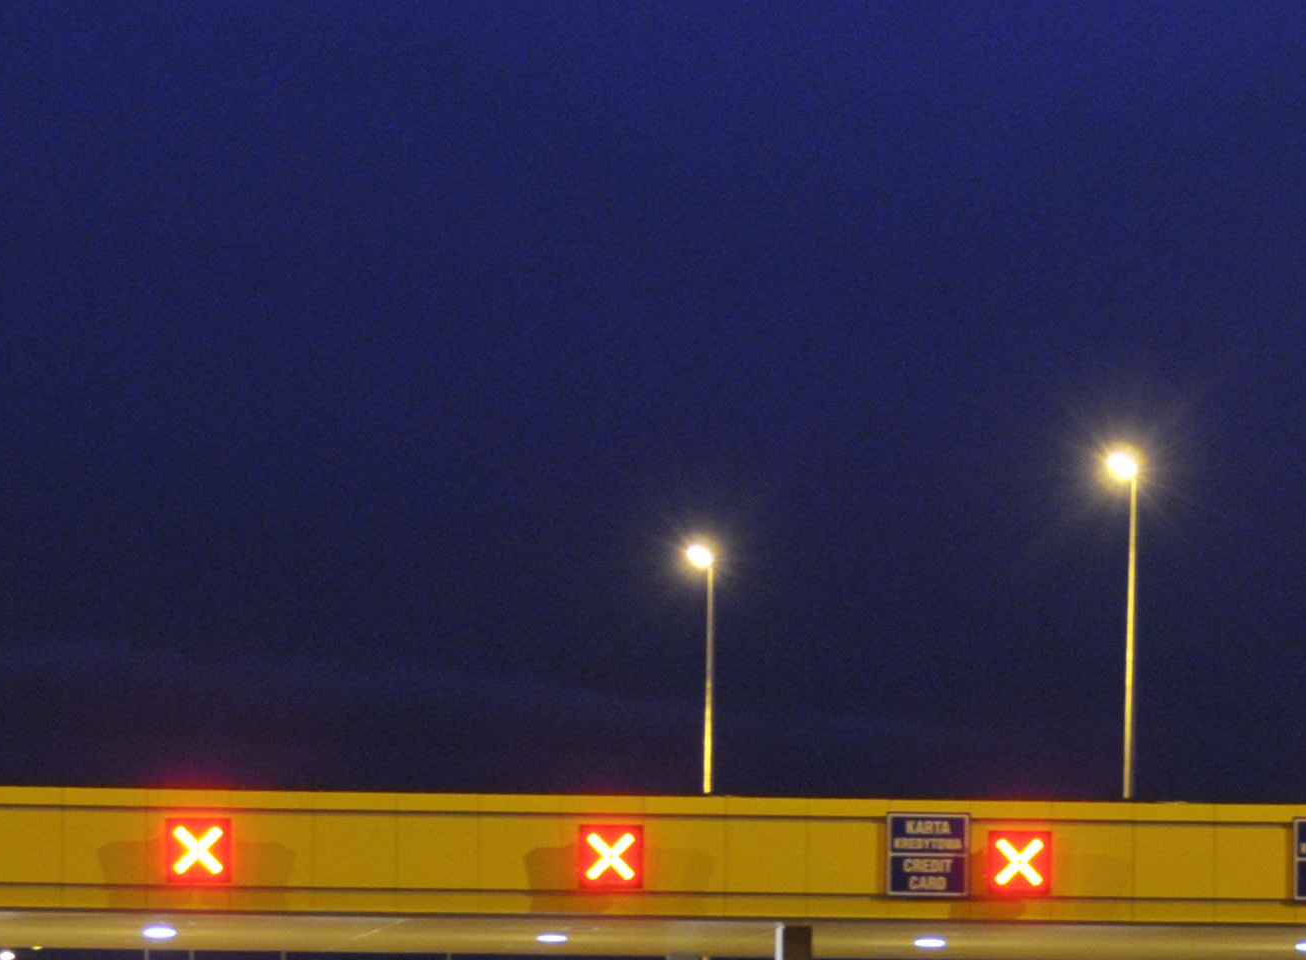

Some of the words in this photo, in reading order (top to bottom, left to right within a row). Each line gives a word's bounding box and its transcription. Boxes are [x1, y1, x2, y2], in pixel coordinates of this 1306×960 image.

[906, 820, 951, 834] KARTA
[903, 858, 953, 873] CREDIT
[909, 876, 947, 890] CARD
